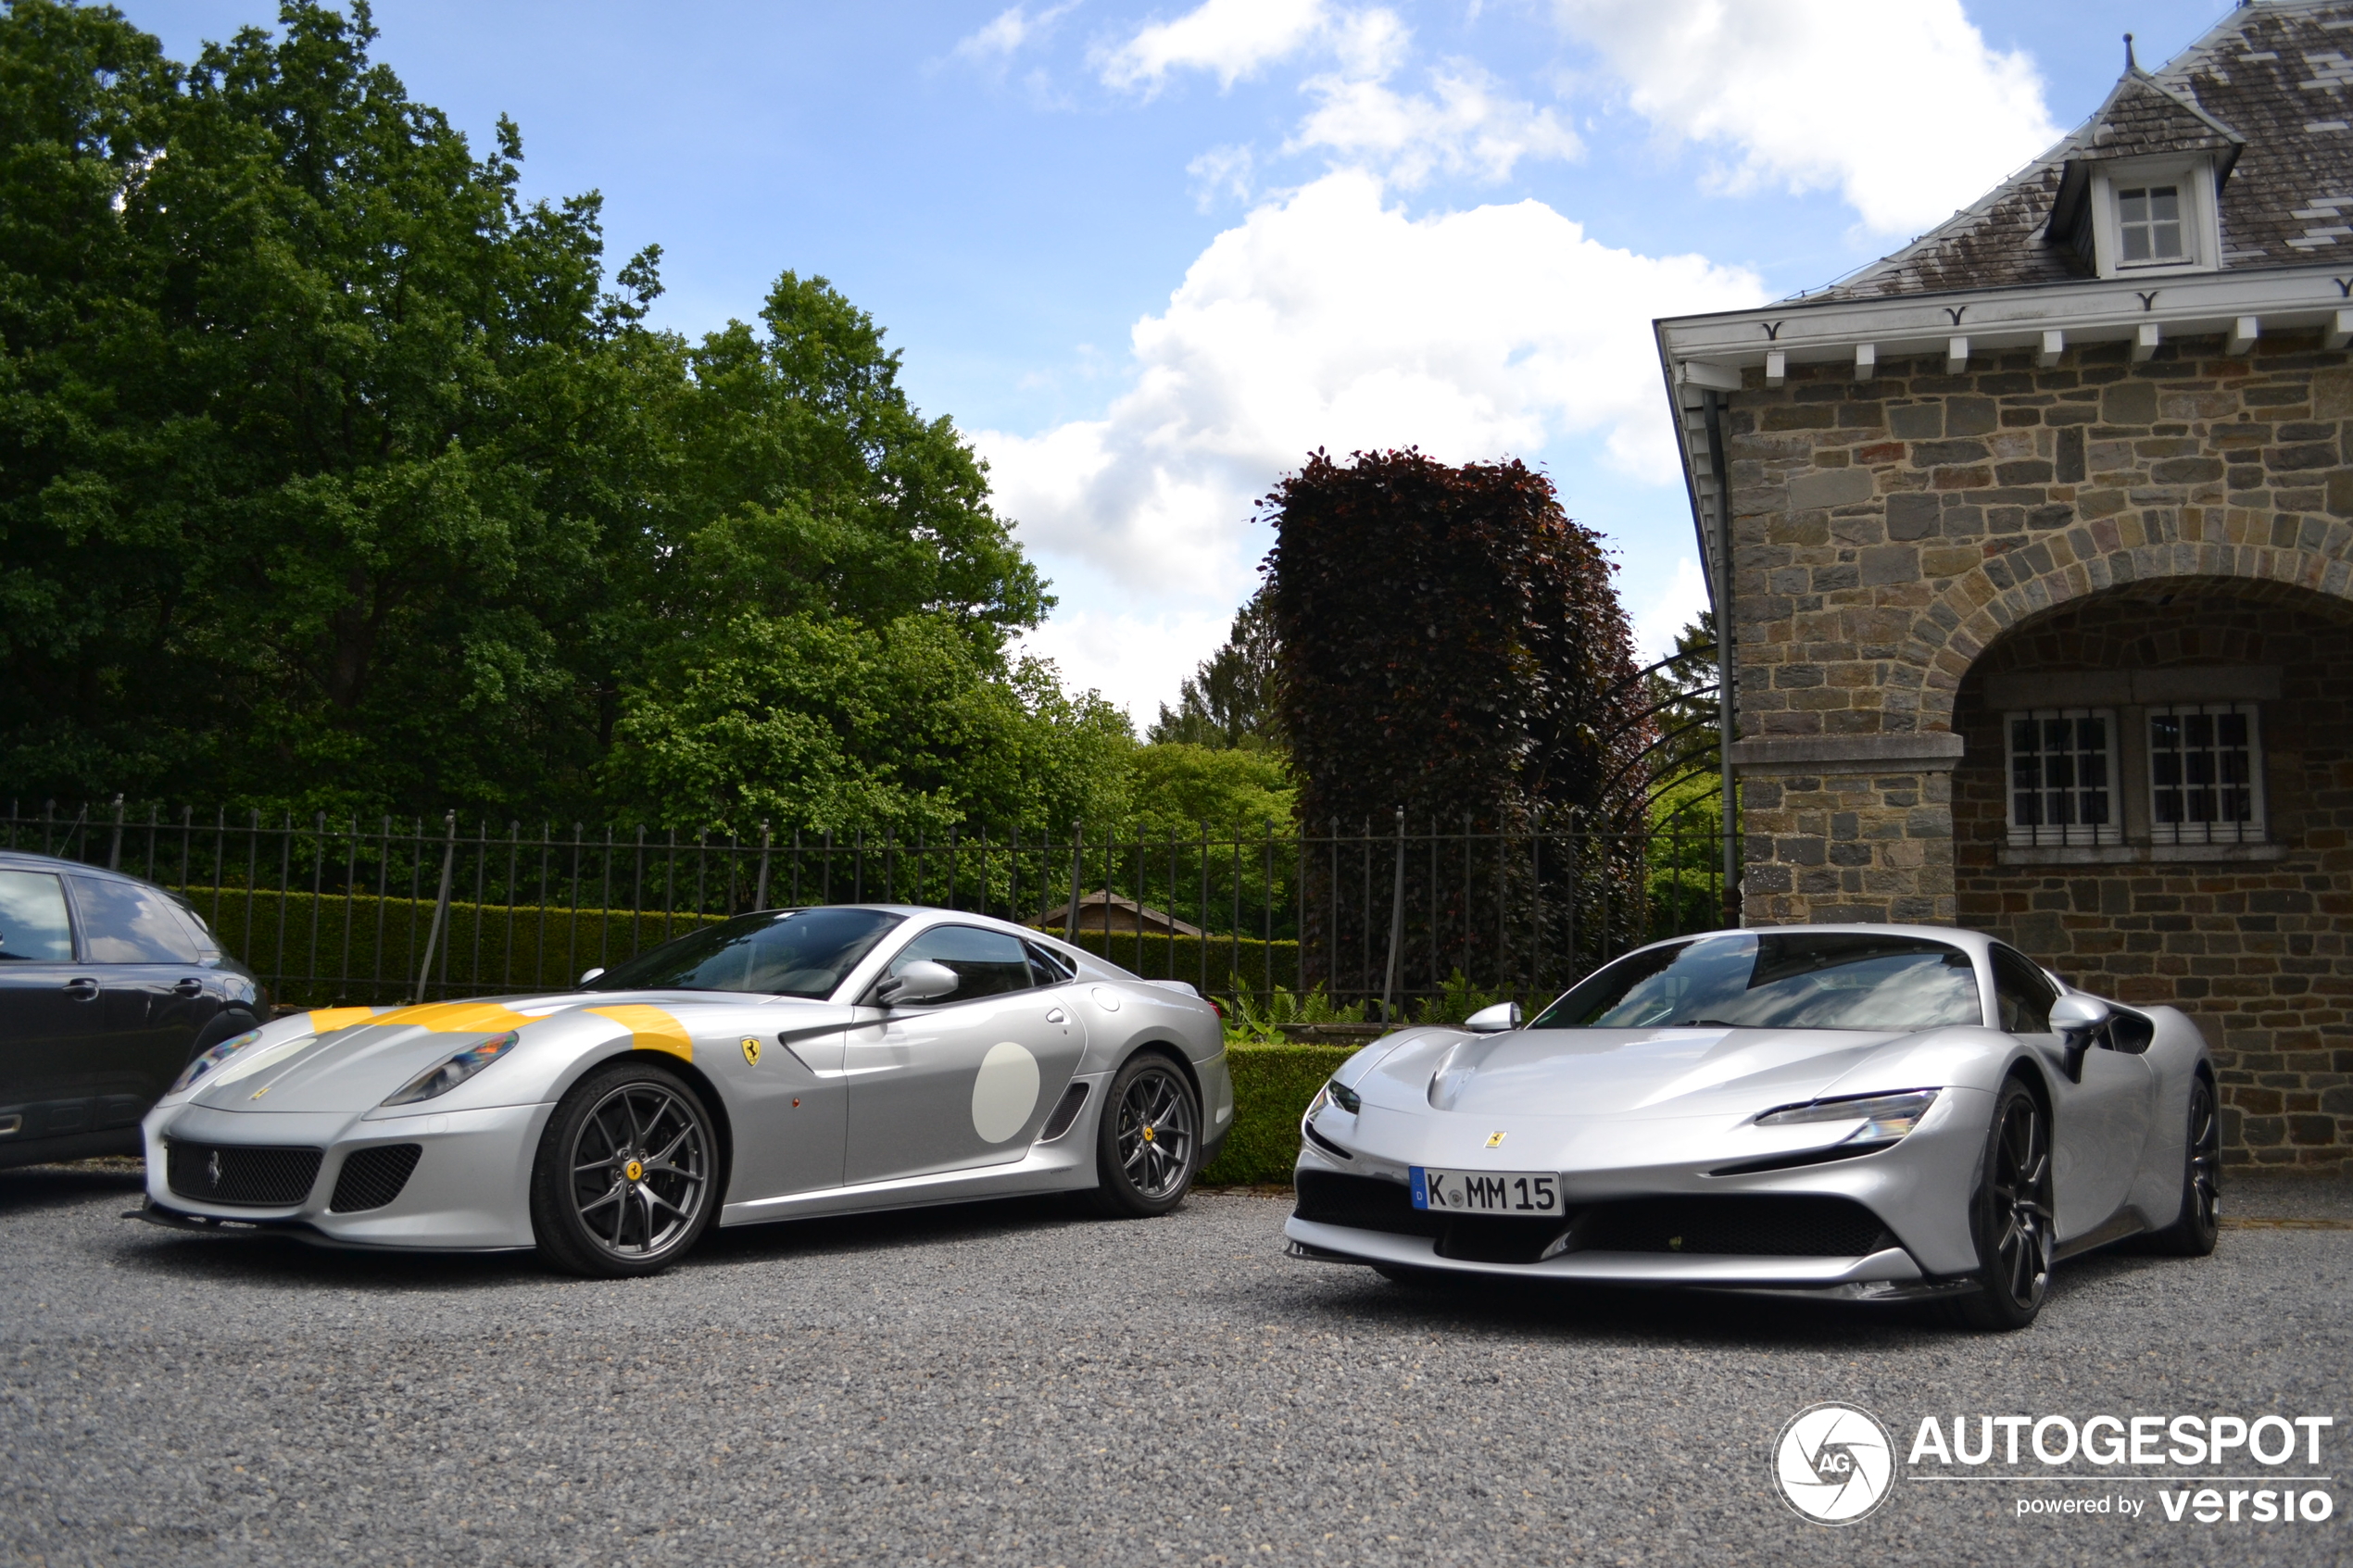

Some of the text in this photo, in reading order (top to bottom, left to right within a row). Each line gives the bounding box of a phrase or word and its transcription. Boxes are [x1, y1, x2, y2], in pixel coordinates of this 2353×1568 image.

[1416, 1191, 1423, 1201] D
[1427, 1173, 1555, 1210] K MM 15
